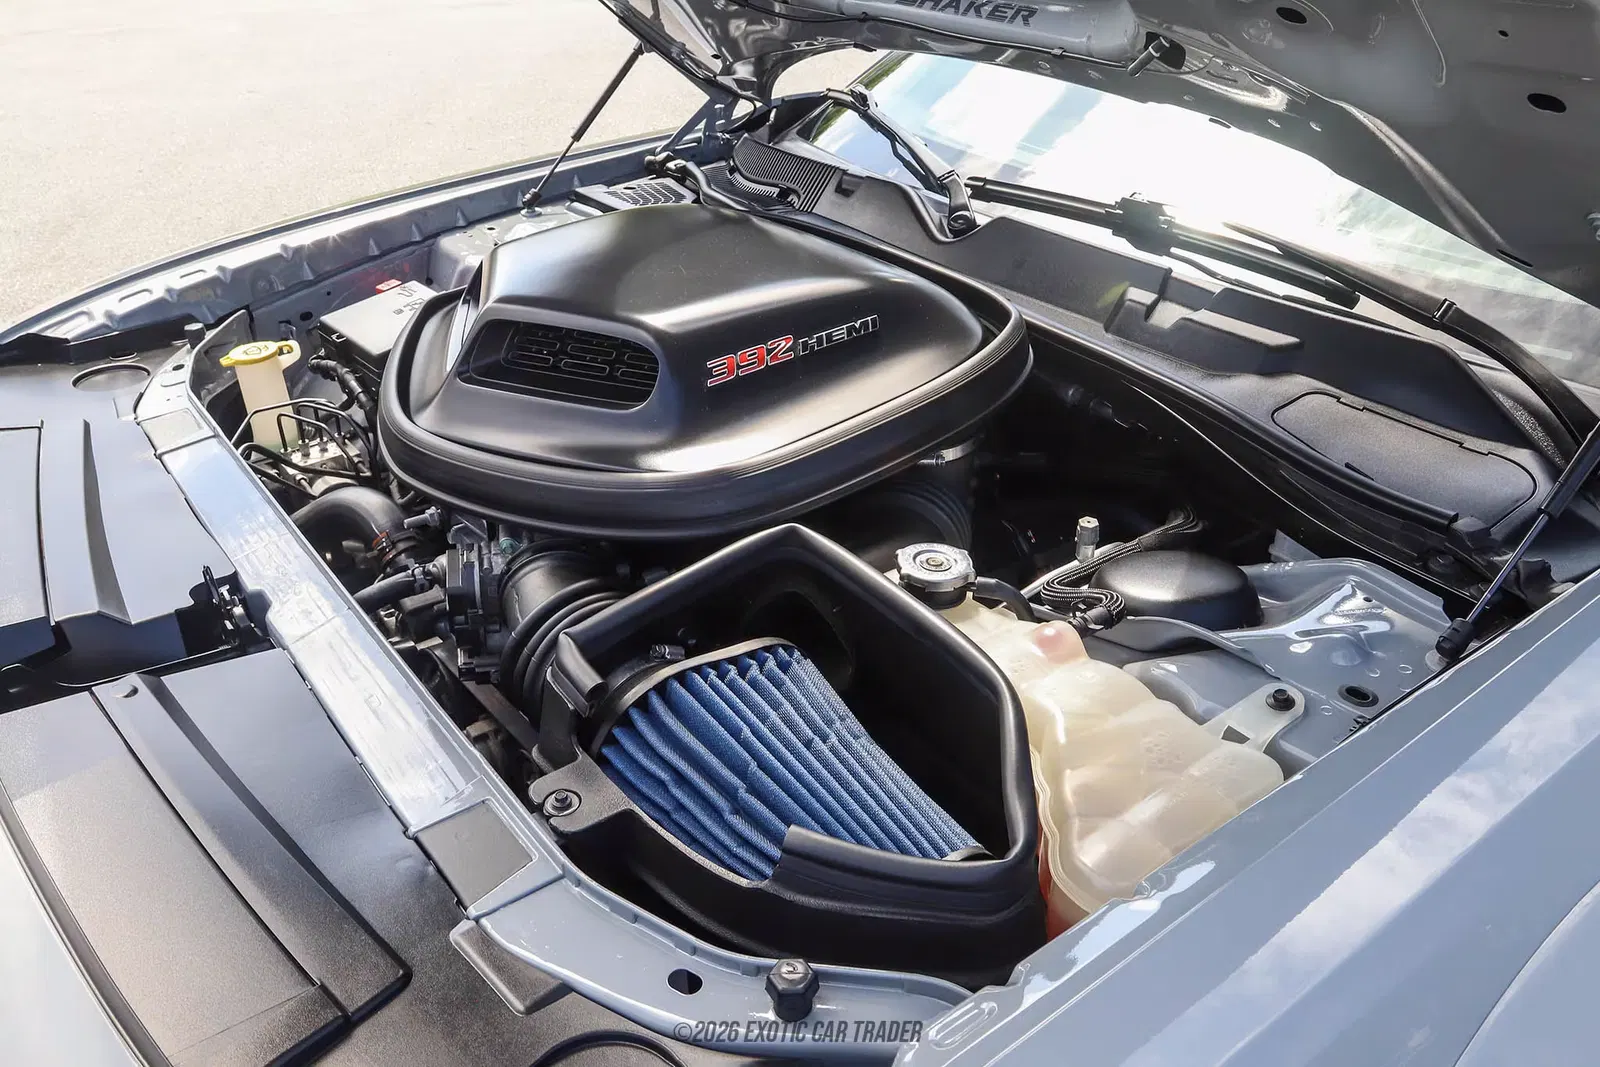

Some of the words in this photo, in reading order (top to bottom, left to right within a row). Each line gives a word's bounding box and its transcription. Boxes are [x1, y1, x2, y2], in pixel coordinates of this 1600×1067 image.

[895, 0, 1039, 27] AKER
[706, 334, 795, 387] 392
[798, 314, 880, 356] HEMI
